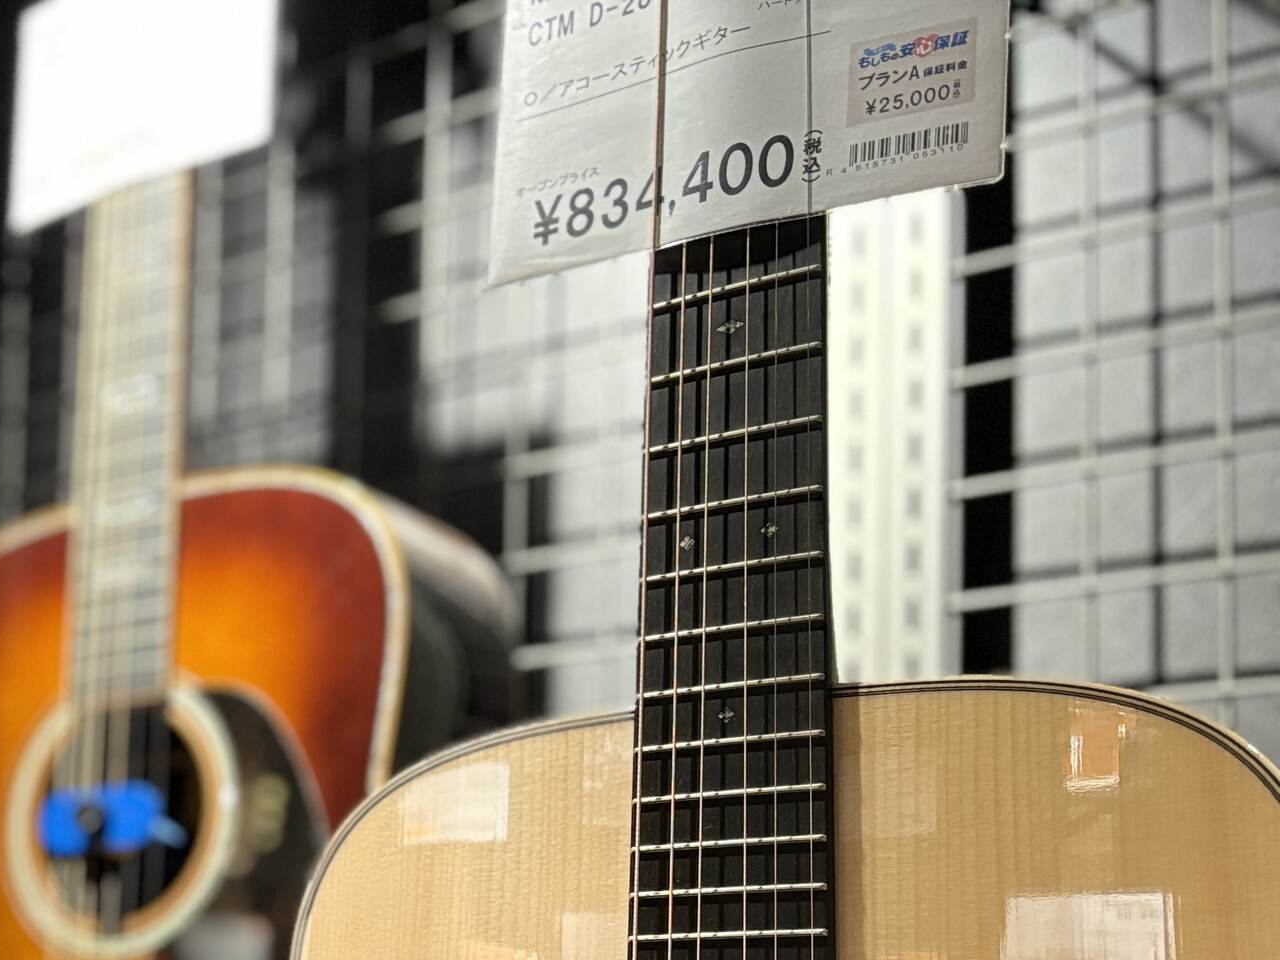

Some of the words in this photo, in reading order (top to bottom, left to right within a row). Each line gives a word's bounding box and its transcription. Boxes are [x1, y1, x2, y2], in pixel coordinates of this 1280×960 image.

[528, 10, 575, 46] CTM
[858, 65, 920, 91] プランA
[533, 134, 795, 246] ¥834,400
